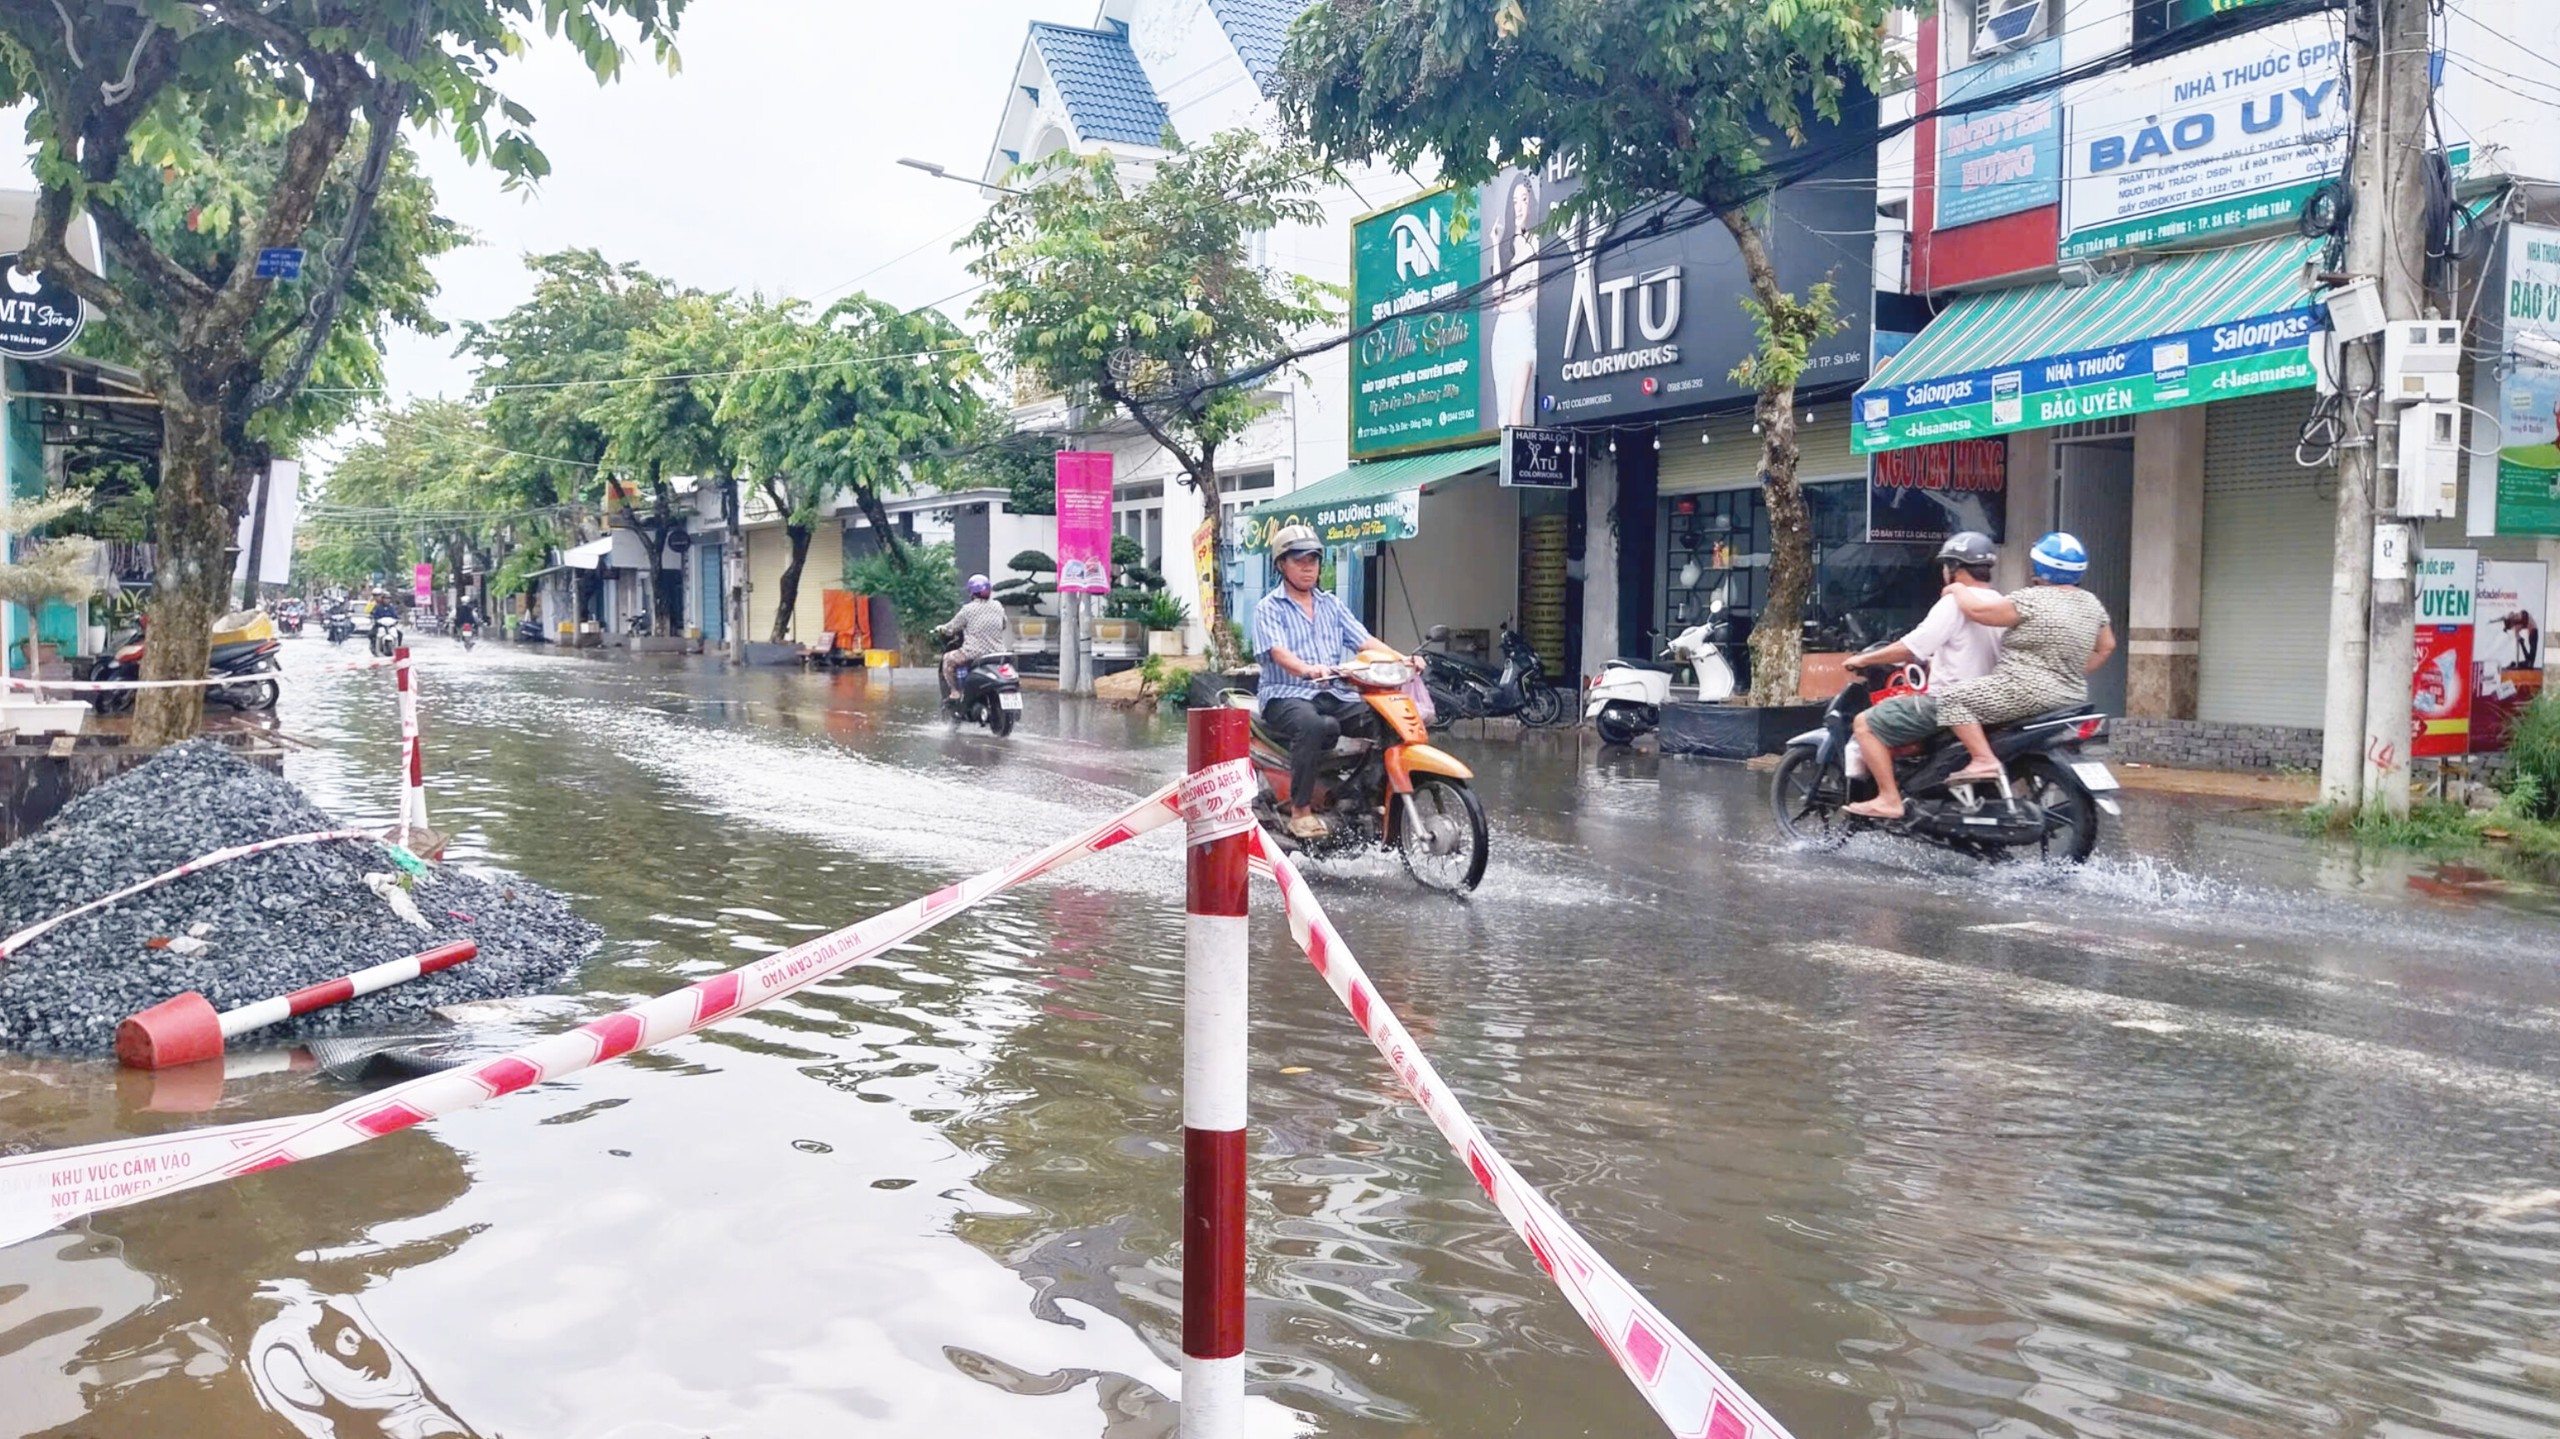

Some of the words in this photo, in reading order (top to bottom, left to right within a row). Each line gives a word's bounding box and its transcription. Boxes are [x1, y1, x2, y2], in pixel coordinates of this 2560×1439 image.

[2173, 72, 2217, 102] NHÀ
[2222, 50, 2290, 89] THUỐC
[2090, 114, 2215, 174] BẢO
[2510, 268, 2543, 320] BẢO
[37, 305, 75, 327] Store
[2212, 315, 2309, 353] Salonpas
[1561, 344, 1679, 381] COLORWORKS
[2046, 359, 2074, 383] NHÀ
[2078, 348, 2126, 378] THUỐC
[1905, 378, 1973, 407] Salonpas
[2041, 393, 2077, 421] BẢO
[2082, 386, 2133, 416] UYÊN
[1515, 431, 1537, 441] HAIR
[1538, 433, 1568, 442] SALON
[1519, 470, 1563, 480] COLORWORKS
[1317, 511, 1336, 526] SPA
[1337, 504, 1371, 523] DƯỠNG
[1373, 501, 1398, 518] SINH
[2440, 560, 2455, 575] GPP
[2422, 584, 2470, 617] UYÊN
[51, 1168, 83, 1188] KHU
[88, 1160, 119, 1186] VỰC
[161, 1149, 191, 1170] VÀO
[51, 1191, 79, 1209] NOT
